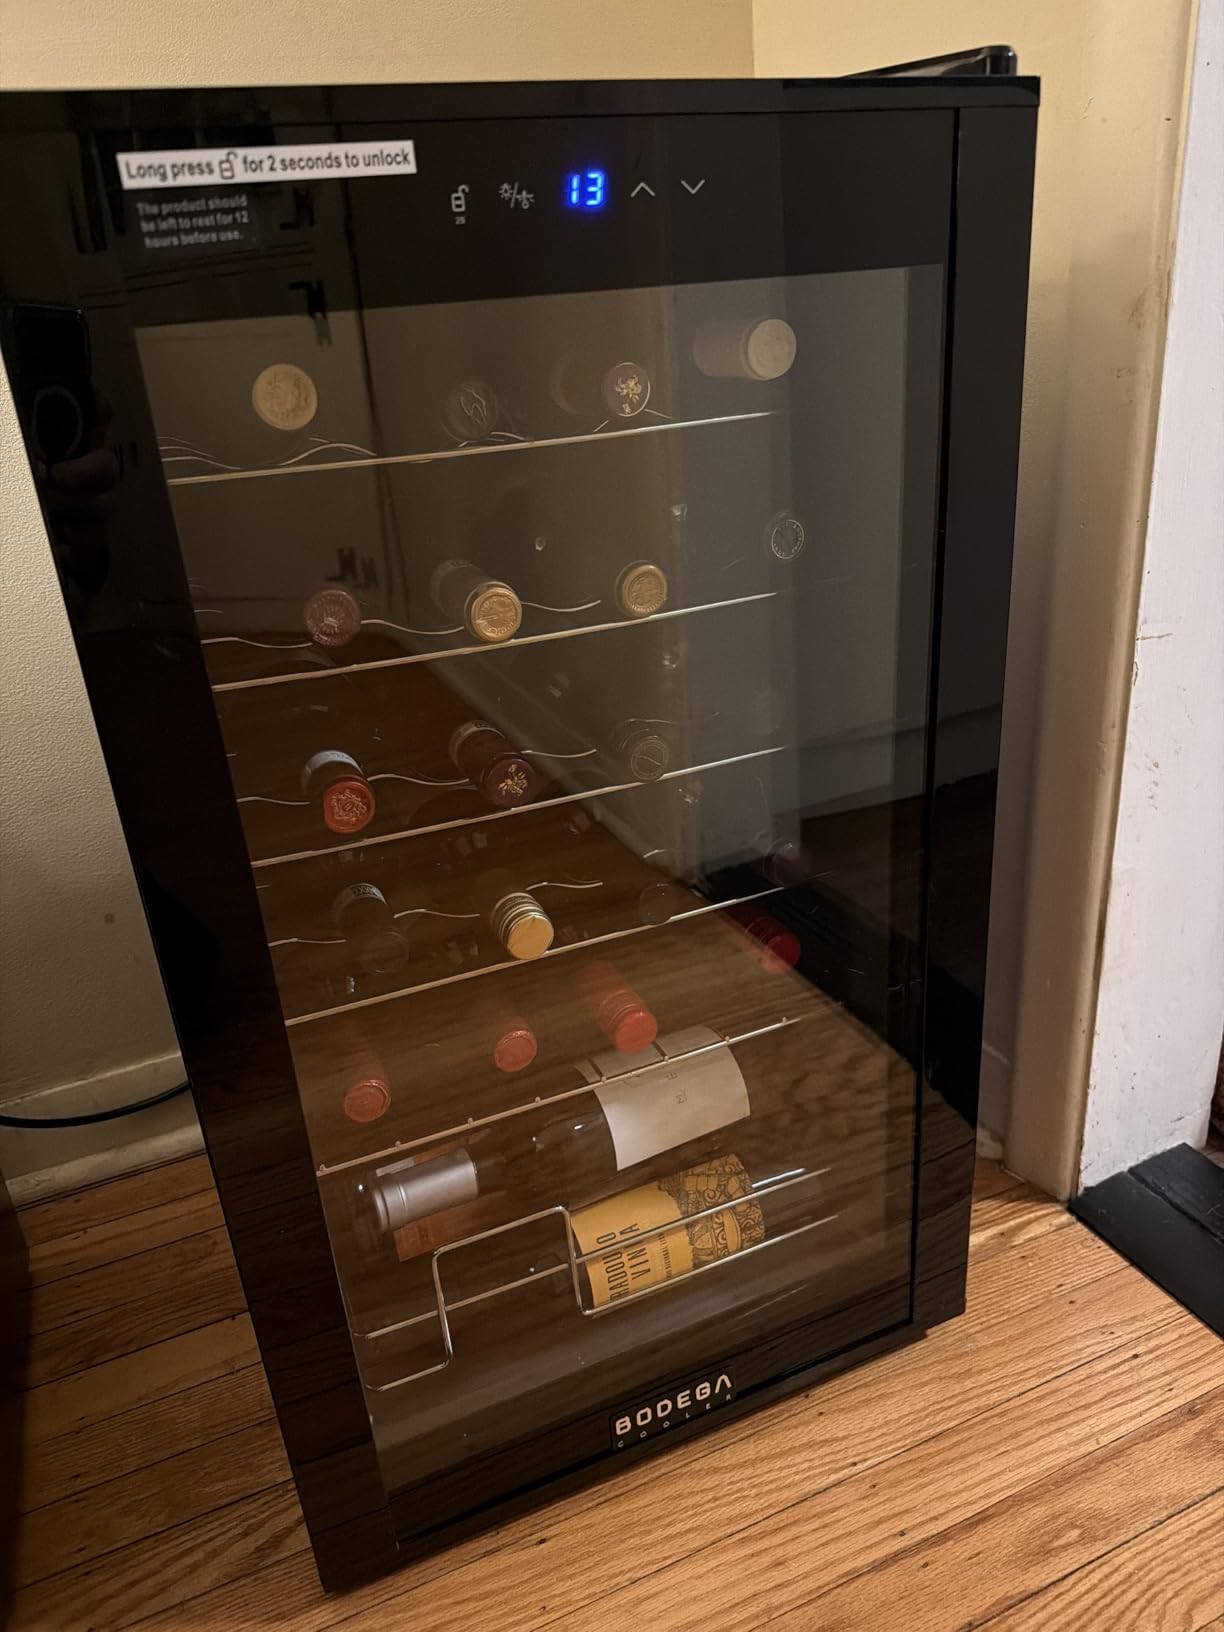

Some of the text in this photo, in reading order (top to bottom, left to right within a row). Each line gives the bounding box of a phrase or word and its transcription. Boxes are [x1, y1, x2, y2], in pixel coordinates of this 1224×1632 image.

[126, 148, 410, 182] Long press for 2 seconds to unlock
[136, 194, 247, 215] The product should
[570, 169, 604, 206] 13
[140, 210, 249, 233] be left to rest for 12
[144, 236, 179, 249] hours
[180, 231, 217, 245] before
[615, 1374, 733, 1436] BODEGA
[617, 1394, 732, 1448] COOLER
